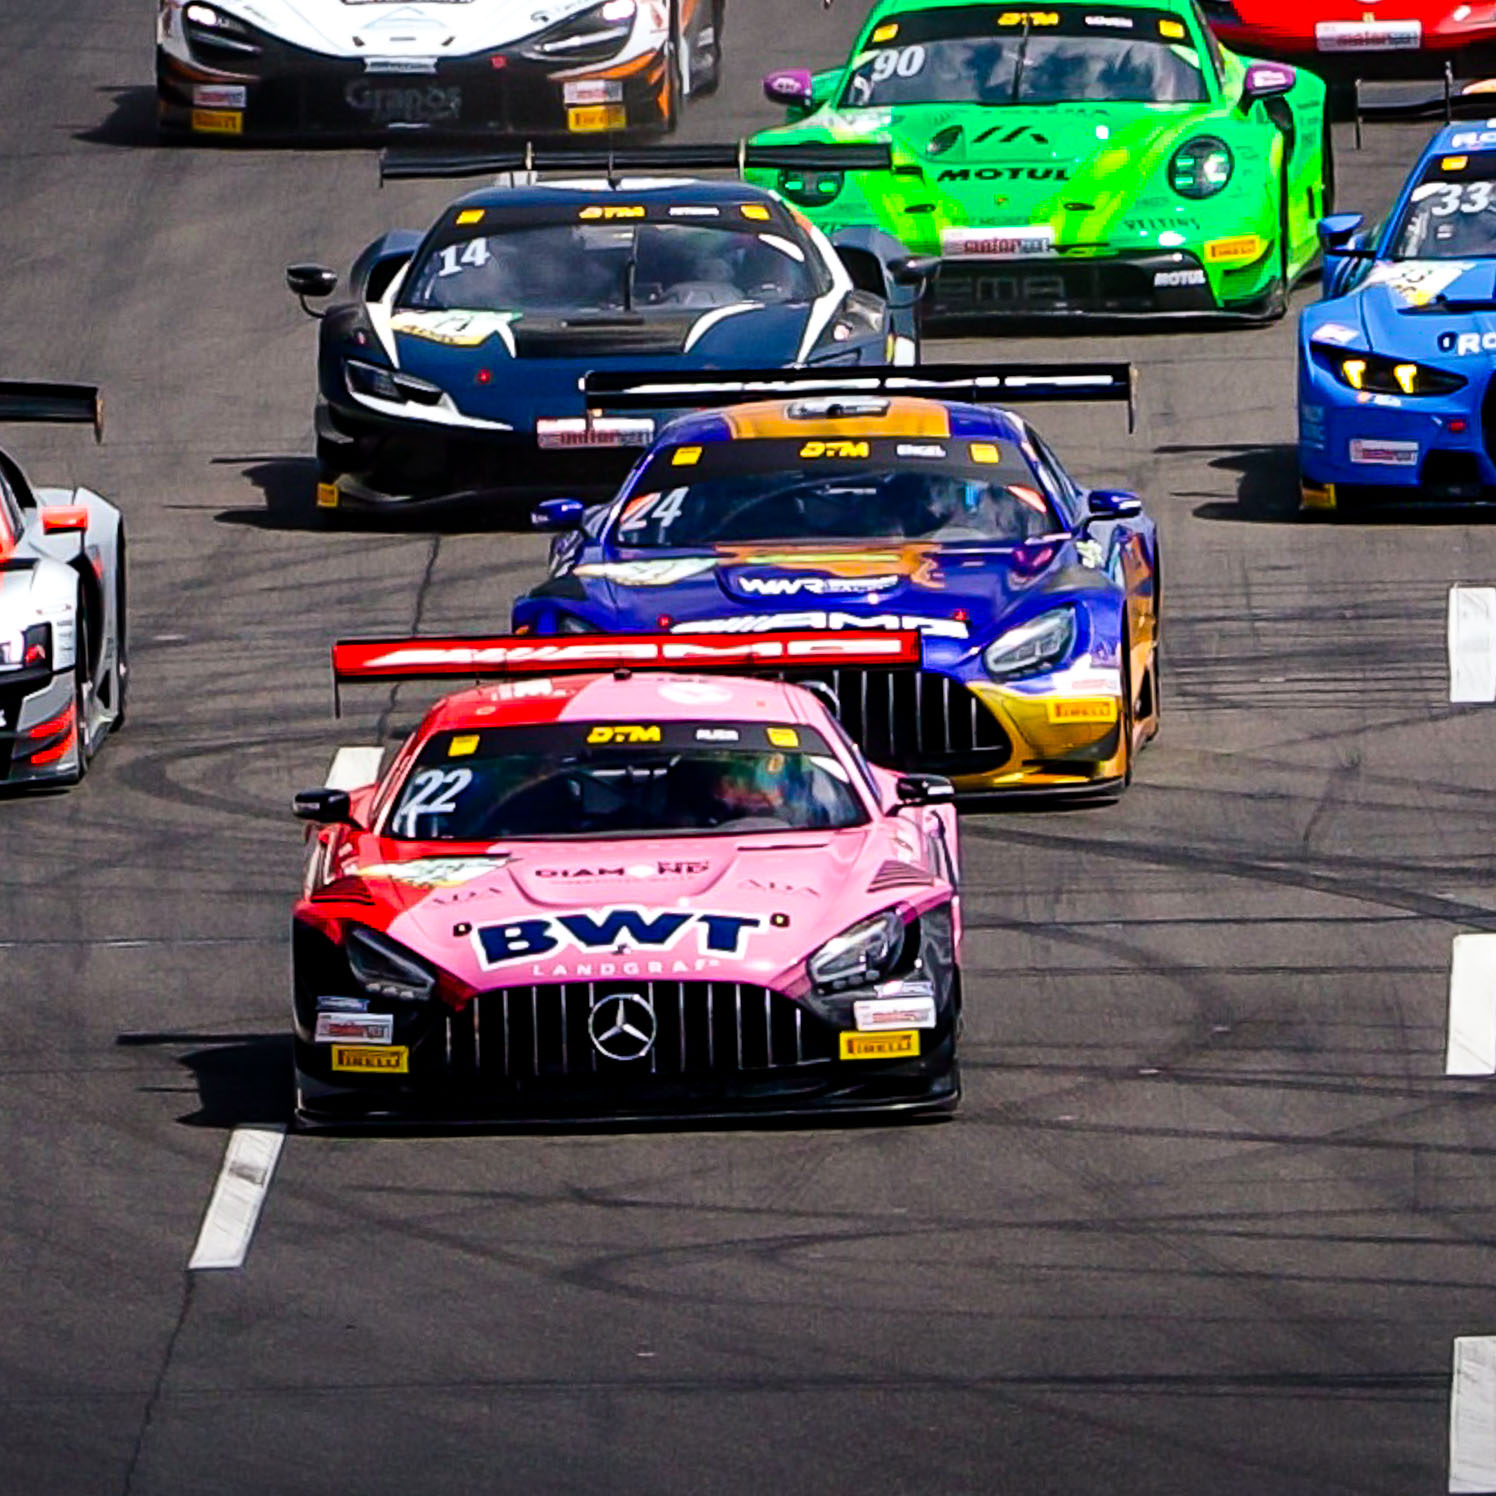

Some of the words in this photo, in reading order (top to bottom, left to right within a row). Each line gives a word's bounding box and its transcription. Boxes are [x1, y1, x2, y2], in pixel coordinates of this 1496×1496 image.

[998, 12, 1059, 25] DTM
[871, 46, 925, 82] 90
[937, 167, 1070, 182] MOTUL
[1432, 181, 1494, 216] 33
[580, 206, 645, 218] DTM
[436, 239, 491, 277] 14
[1154, 270, 1206, 286] MOTUL
[800, 441, 869, 457] DTM
[621, 486, 689, 531] 24
[587, 726, 661, 743] DTM
[411, 768, 473, 814] 22
[477, 909, 761, 964] BWT
[532, 959, 720, 978] LANDGRAF
[847, 1034, 912, 1054] PIRELLI
